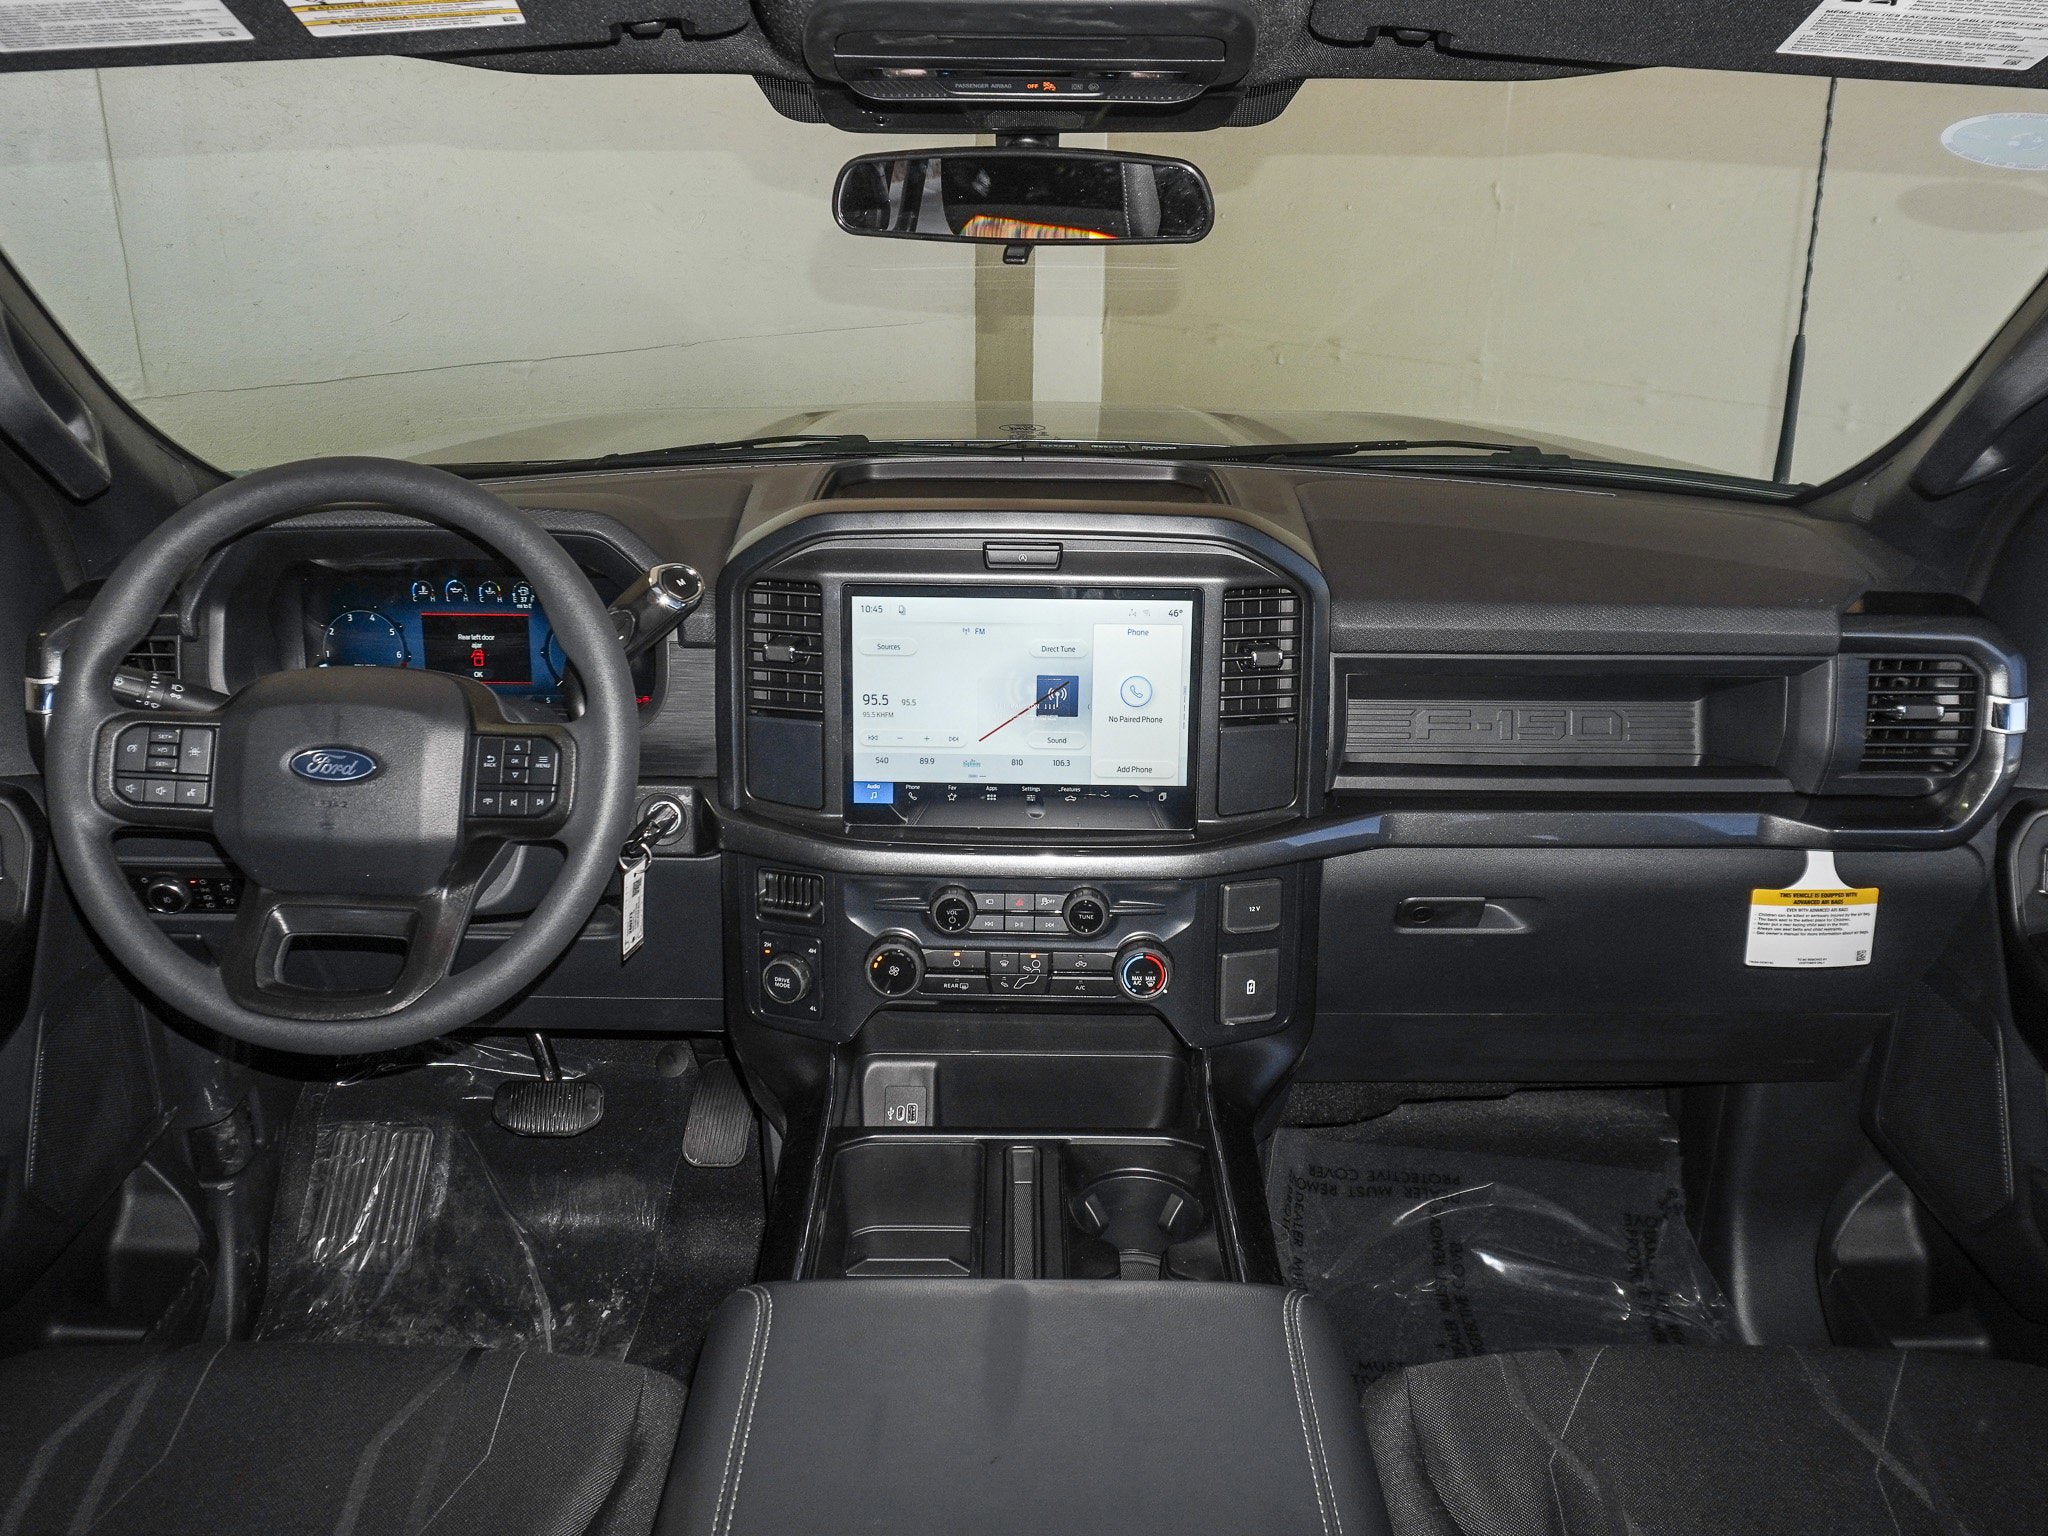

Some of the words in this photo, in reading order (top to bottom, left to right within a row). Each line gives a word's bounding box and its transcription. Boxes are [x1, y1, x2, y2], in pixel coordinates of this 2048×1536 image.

[861, 605, 883, 613] 10:45
[1168, 609, 1183, 617] 46°
[347, 614, 353, 622] 3
[369, 614, 375, 622] 4
[329, 627, 334, 635] 2
[389, 628, 395, 636] 5
[862, 694, 889, 706] 95.5
[1142, 716, 1163, 724] Phone
[1414, 709, 1624, 741] F-150
[306, 752, 358, 777] Ford
[1309, 1164, 1358, 1180] COVER
[1367, 1171, 1460, 1186] PROTECTIVE
[1348, 1185, 1392, 1198] MUST
